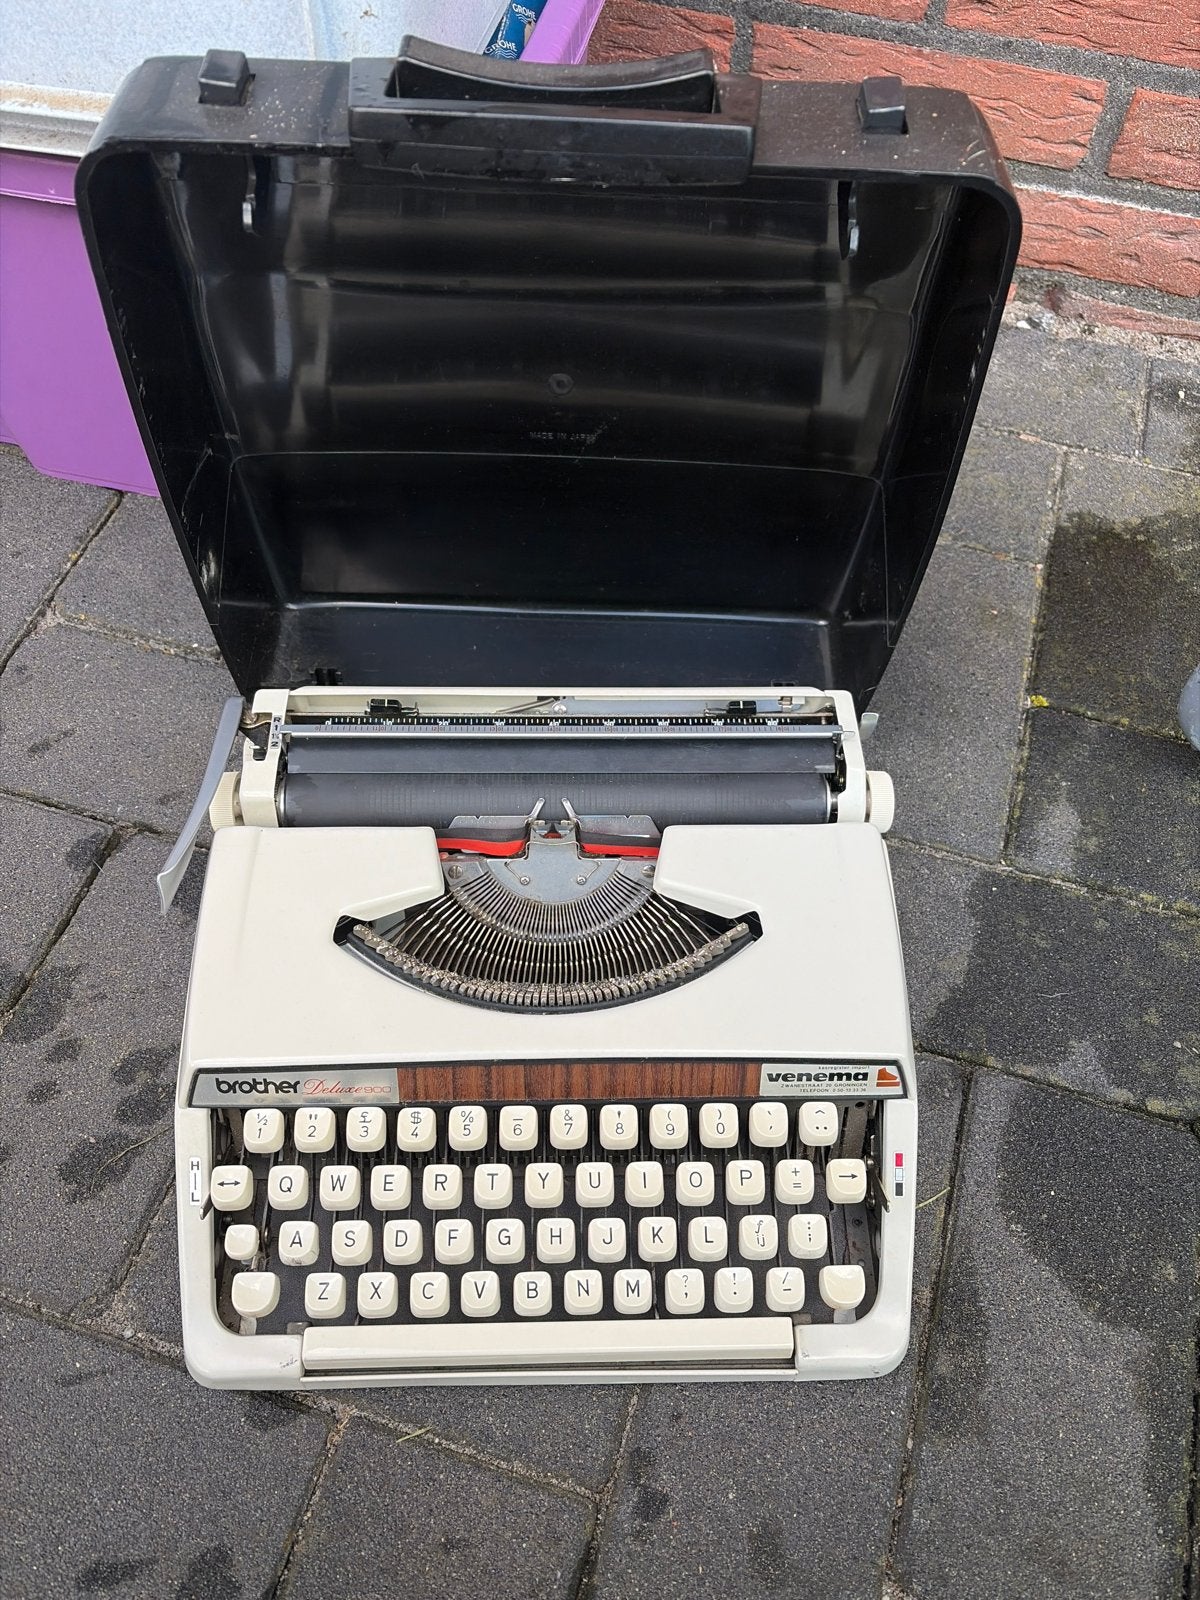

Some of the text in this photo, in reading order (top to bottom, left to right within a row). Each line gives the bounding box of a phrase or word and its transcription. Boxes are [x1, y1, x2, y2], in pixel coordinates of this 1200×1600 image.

[512, 3, 536, 20] GROHE
[484, 39, 518, 54] GROHE
[529, 431, 554, 439] MADE
[557, 432, 567, 440] IN
[766, 1071, 869, 1082] venema
[215, 1077, 391, 1095] brother Deluxe 900
[410, 1110, 422, 1125] $
[460, 1110, 474, 1124] %
[563, 1109, 574, 1122] &
[257, 1127, 262, 1139] 1
[307, 1124, 317, 1138] 2
[359, 1125, 369, 1138] 3
[410, 1126, 419, 1139] 4
[462, 1123, 472, 1137] 5
[513, 1123, 523, 1137] 6
[563, 1122, 573, 1136] 7
[615, 1122, 625, 1135] 8
[665, 1123, 675, 1136] 9
[715, 1122, 726, 1135] 0
[190, 1160, 200, 1171] H
[278, 1175, 293, 1193] Q
[330, 1174, 348, 1192] W
[383, 1173, 395, 1192] E
[434, 1173, 448, 1192] R
[486, 1172, 499, 1191] T
[537, 1171, 550, 1190] Y
[588, 1171, 601, 1189] U
[642, 1171, 647, 1189] I
[689, 1171, 703, 1189] O
[739, 1169, 753, 1187] P
[191, 1192, 200, 1202] L
[289, 1230, 303, 1248] A
[344, 1229, 356, 1248] S
[394, 1229, 408, 1248] D
[447, 1228, 459, 1247] F
[497, 1227, 511, 1246] G
[549, 1227, 562, 1246] H
[602, 1227, 613, 1245] J
[651, 1225, 664, 1244] K
[704, 1225, 715, 1244] L
[317, 1281, 330, 1301] Z
[369, 1281, 383, 1300] X
[422, 1281, 435, 1300] C
[473, 1280, 487, 1300] V
[526, 1280, 539, 1299] B
[576, 1278, 590, 1298] N
[625, 1279, 641, 1298] M
